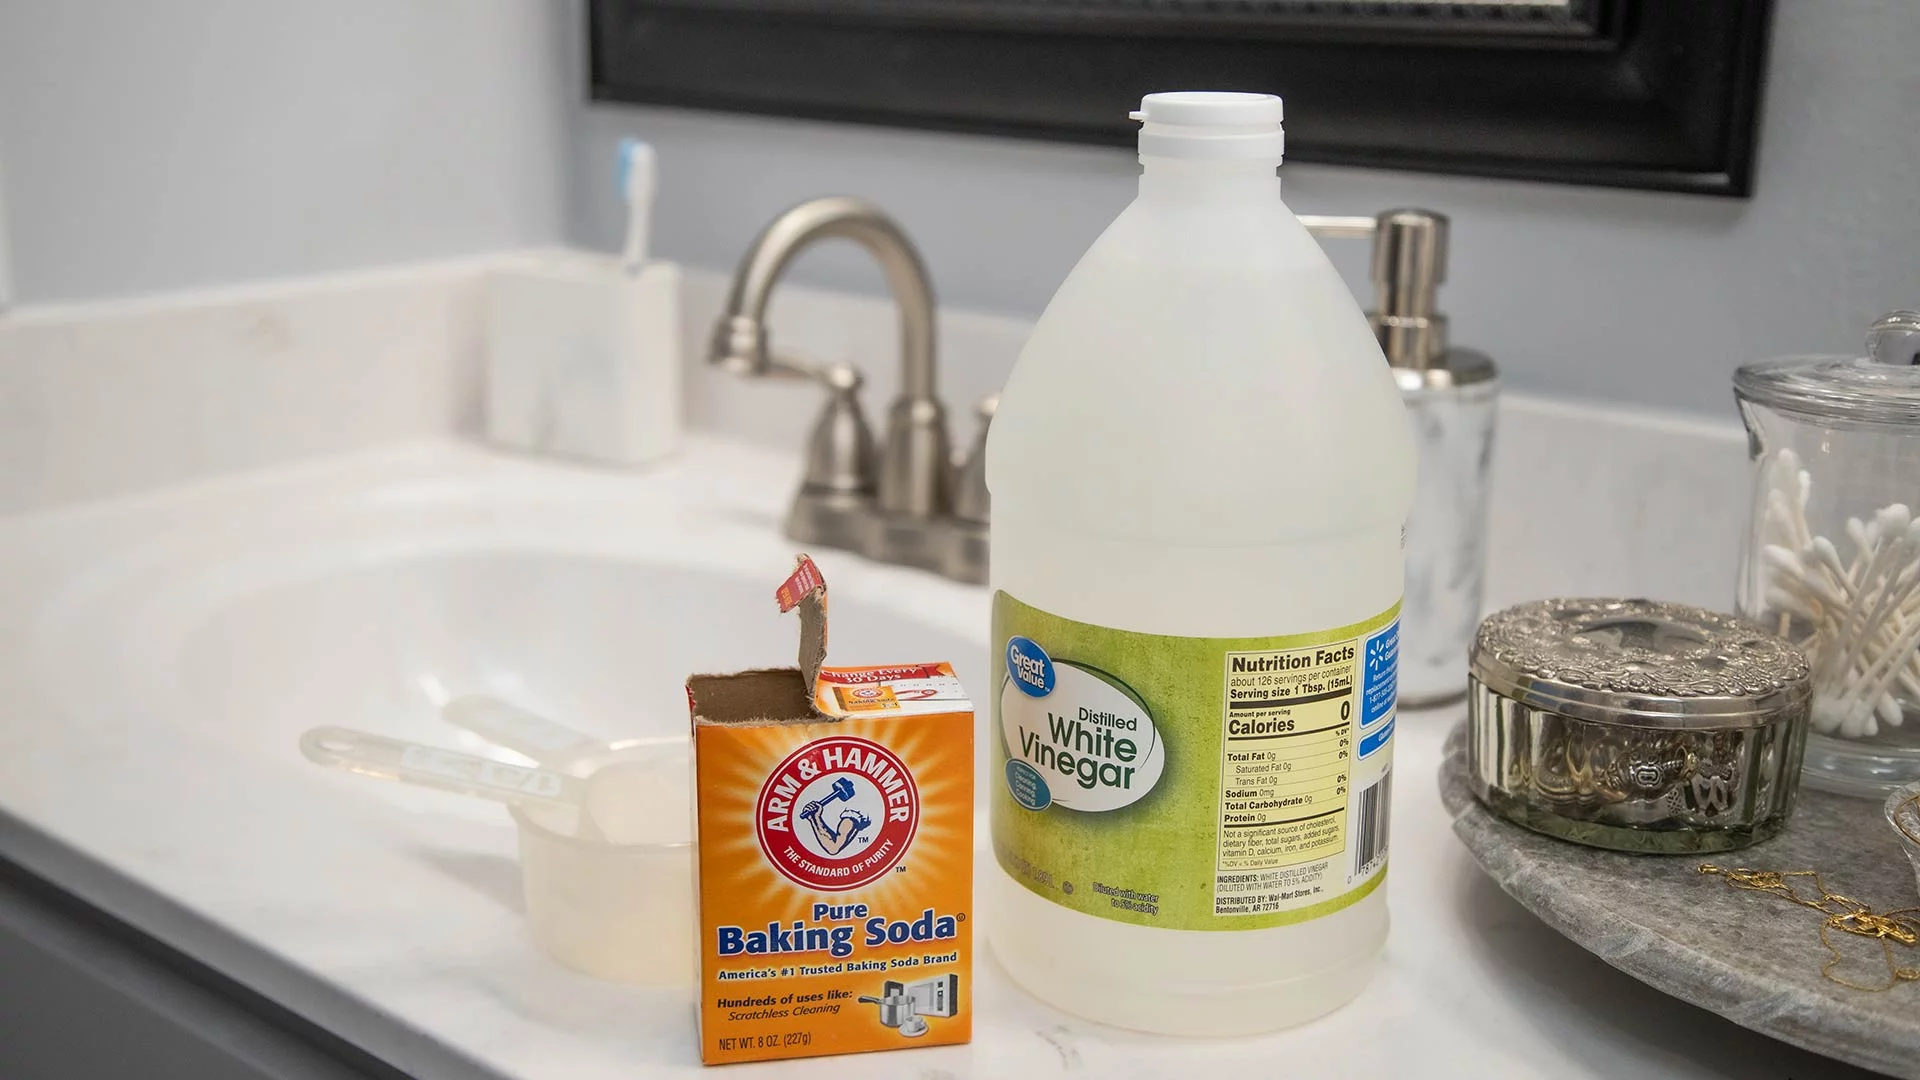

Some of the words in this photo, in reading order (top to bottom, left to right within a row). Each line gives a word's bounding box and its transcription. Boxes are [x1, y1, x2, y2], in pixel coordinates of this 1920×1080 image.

[1010, 645, 1045, 677] Great
[1232, 653, 1311, 673] Nutrition
[1315, 647, 1355, 666] Facts
[821, 669, 874, 680] Change
[879, 666, 917, 675] Every
[866, 674, 902, 682] Days
[1017, 667, 1045, 690] Value
[1230, 677, 1255, 687] about
[1257, 676, 1272, 686] 126
[1274, 673, 1307, 686] servings
[1308, 673, 1319, 682] per
[1321, 665, 1352, 679] container
[1230, 687, 1269, 700] Serving
[1271, 688, 1291, 697] size
[1294, 686, 1299, 695] 1
[1302, 683, 1325, 695] Tbsp.
[1327, 675, 1353, 691] (15mL)
[1079, 707, 1137, 731] Distilled
[1228, 717, 1295, 735] Calories
[1340, 700, 1350, 721] 0
[1229, 710, 1255, 718] Amount
[1268, 708, 1291, 718] serving
[1048, 712, 1137, 763] White
[1339, 738, 1349, 748] 0%
[1019, 725, 1136, 790] Vinegar
[1227, 753, 1250, 762] Total
[1251, 753, 1265, 761] Fat
[1266, 752, 1276, 761] 0g
[1338, 750, 1348, 760] 0%
[1235, 764, 1270, 775] Saturated
[1271, 763, 1282, 772] Fat
[1283, 762, 1292, 772] 0g
[1235, 777, 1255, 786] Trans
[1256, 776, 1268, 785] Fat
[1268, 775, 1278, 785] 0g
[1337, 774, 1347, 783] 0%
[767, 773, 803, 833] ARM
[798, 758, 822, 781] &
[822, 747, 910, 823] HAMMER
[1225, 789, 1258, 799] Sodium
[1259, 788, 1275, 797] 0mg
[1336, 786, 1346, 795] 0%
[1225, 802, 1247, 811] Total
[1249, 796, 1303, 810] Carbohydrate
[1304, 795, 1313, 804] 0g
[1224, 813, 1256, 823] Protein
[1257, 813, 1266, 823] 0g
[1223, 830, 1236, 839] Not
[1243, 827, 1277, 840] significant
[1277, 825, 1298, 835] source
[1223, 838, 1246, 849] dietary
[1265, 835, 1280, 844] total
[1303, 828, 1321, 840] added
[1222, 847, 1247, 857] vitamin
[1298, 839, 1311, 850] and
[783, 845, 801, 864] THE
[798, 860, 850, 878] STANDARD
[852, 863, 865, 874] OF
[866, 839, 894, 868] PURITY
[1216, 874, 1259, 884] INGREDIENTS:
[1260, 872, 1279, 881] WHITE
[1280, 867, 1307, 878] DISTILLED
[1307, 861, 1329, 873] VINEGAR
[1092, 882, 1119, 897] Diluted
[1120, 889, 1136, 899] with
[1137, 892, 1159, 903] water
[1246, 882, 1261, 891] WITH
[1262, 880, 1283, 890] WATER
[1283, 879, 1292, 887] TO
[1216, 896, 1255, 906] DISTRIBUTED
[1257, 895, 1267, 904] BY:
[1268, 891, 1294, 903] Wal-Mart
[813, 903, 868, 921] Pure
[1133, 902, 1160, 916] acidity
[1252, 904, 1261, 912] AR
[718, 921, 853, 957] Baking
[866, 908, 956, 946] Soda
[780, 968, 795, 977] #1
[800, 963, 842, 976] Trusted
[847, 960, 887, 973] Baking
[891, 956, 919, 968] Soda
[923, 952, 957, 964] Brand
[717, 995, 776, 1008] Hundreds
[780, 993, 793, 1005] of
[797, 993, 823, 1004] uses
[827, 989, 853, 1002] like:
[728, 1009, 789, 1021] Scratchless
[793, 1003, 840, 1017] Cleaning
[719, 1038, 736, 1050] NET
[738, 1036, 755, 1049] WT.
[758, 1036, 764, 1048] 8
[766, 1034, 781, 1047] OZ.
[784, 1032, 811, 1047] (227g)
